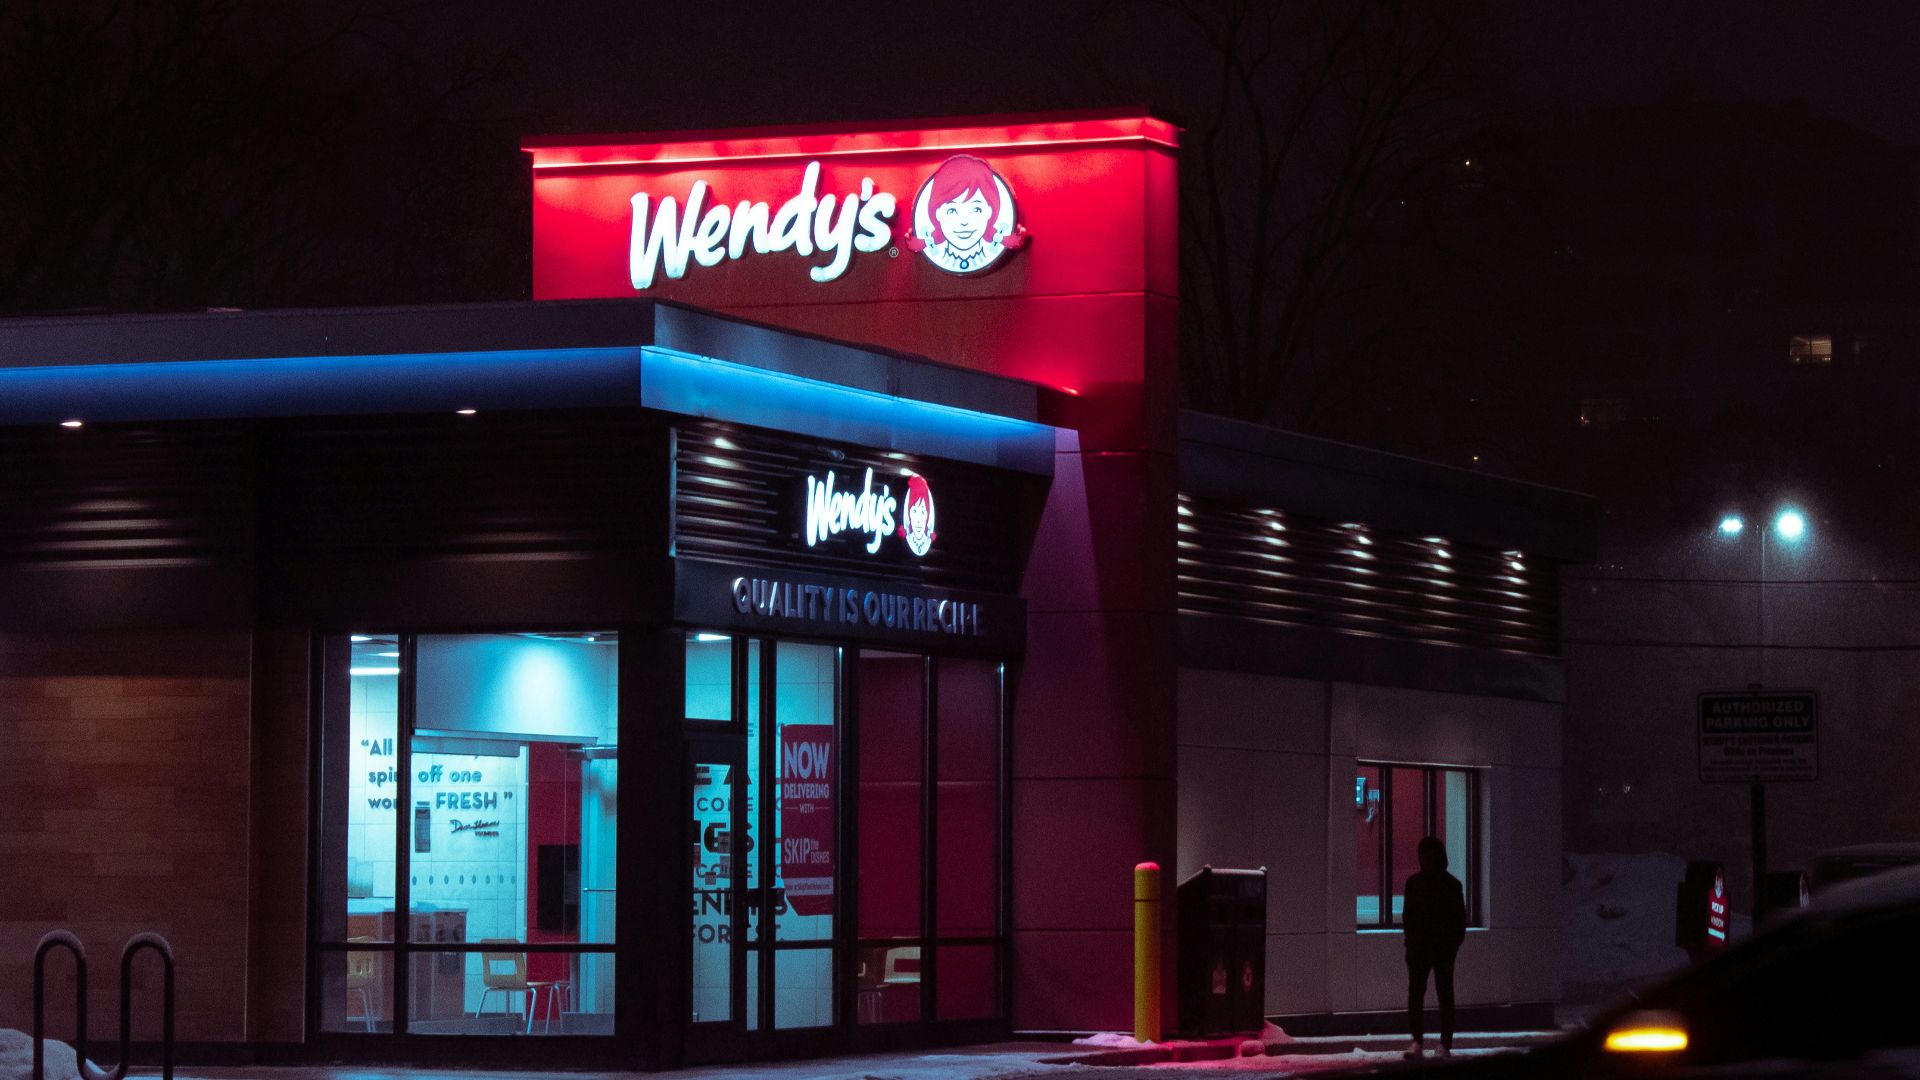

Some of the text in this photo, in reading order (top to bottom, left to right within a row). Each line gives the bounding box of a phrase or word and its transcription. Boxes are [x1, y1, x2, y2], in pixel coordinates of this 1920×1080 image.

[630, 160, 896, 289] Wendy's
[806, 467, 896, 554] Wendy's
[732, 576, 834, 622] QUALITY
[839, 587, 859, 624] IS
[863, 590, 910, 631] OUR
[1712, 700, 1804, 713] AUTHORIZED
[1705, 714, 1810, 729] PARKING ONLY
[784, 740, 830, 779] NOW
[418, 764, 443, 783] off
[449, 770, 482, 783] one
[784, 783, 830, 799] DELIVERING
[799, 803, 814, 814] WITH
[784, 837, 810, 863] SKIP
[810, 850, 830, 864] DISHES
